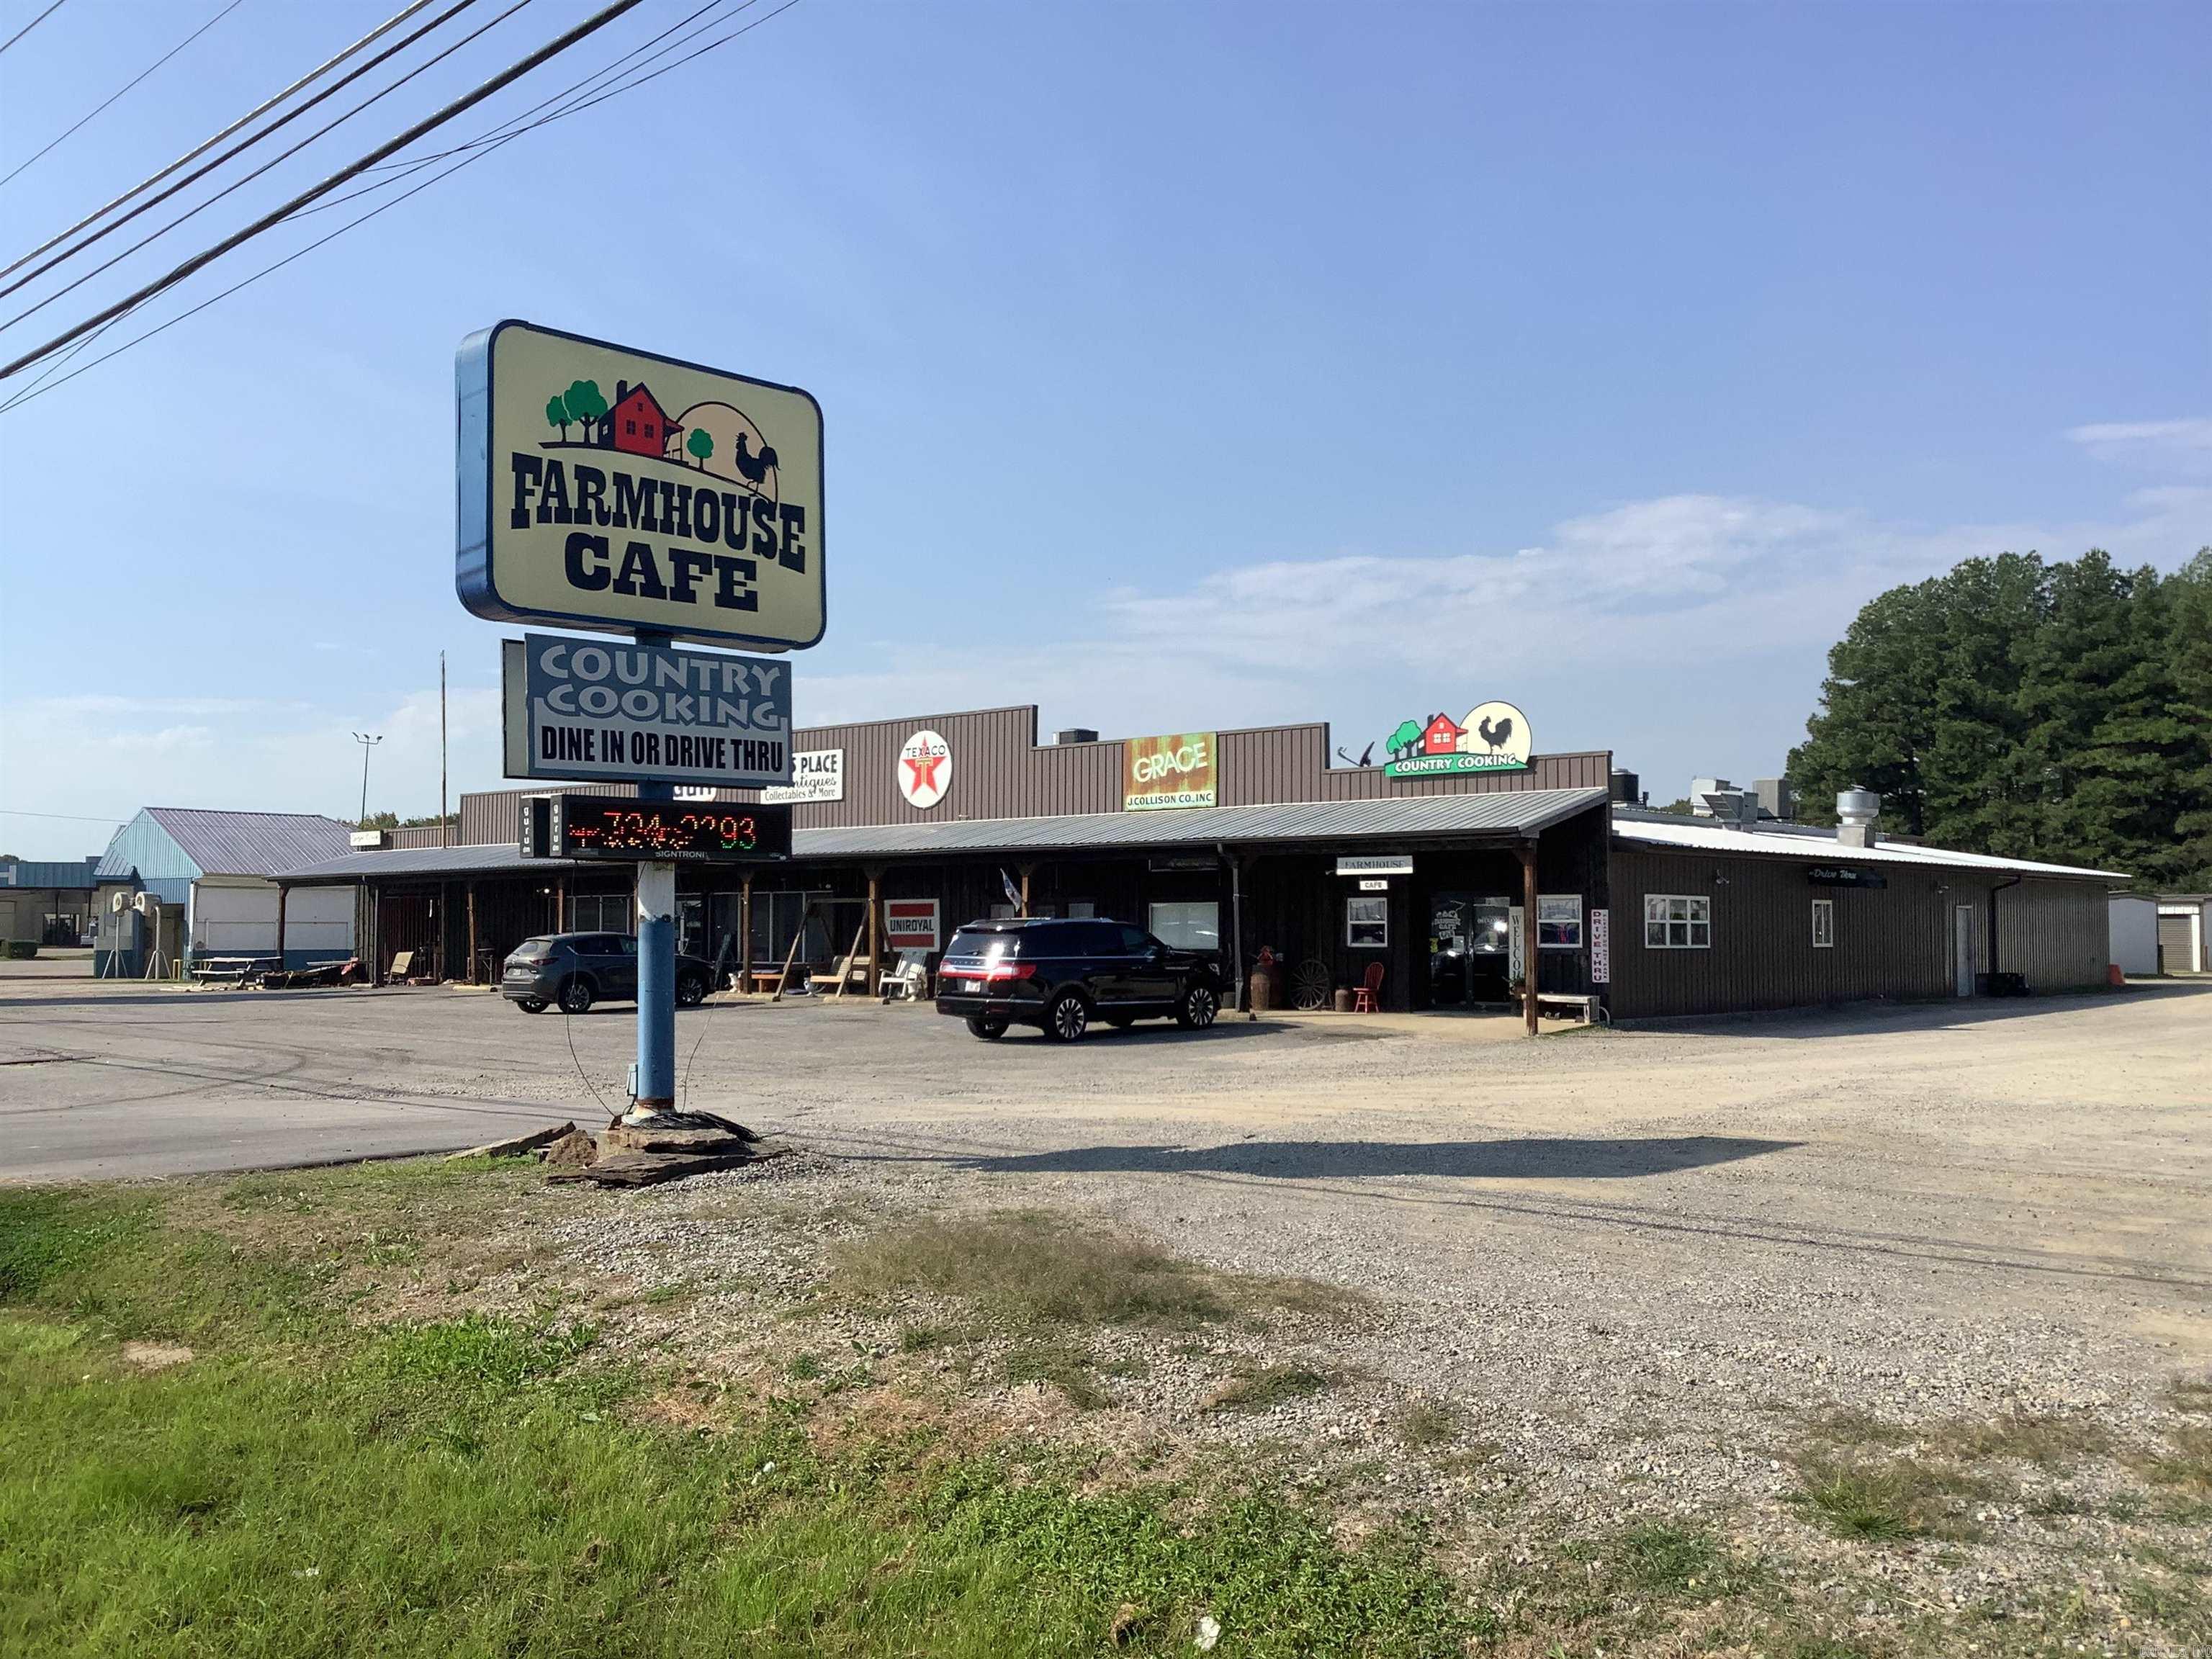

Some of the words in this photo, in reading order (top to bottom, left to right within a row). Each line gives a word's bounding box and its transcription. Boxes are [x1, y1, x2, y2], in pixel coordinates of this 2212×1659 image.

[511, 451, 806, 575] FARMHOUSE
[565, 531, 759, 612] CAFE
[540, 644, 781, 696] COUNTRY
[547, 683, 778, 727] COOKING
[541, 725, 595, 762] DINE
[601, 729, 625, 763] IN
[631, 731, 660, 765] OR
[665, 734, 727, 769] DRIVE
[730, 738, 783, 773] THRU
[801, 754, 837, 773] PLACE
[905, 745, 946, 757] TEXACO
[1133, 742, 1208, 783] GRACE
[1395, 758, 1453, 773] COUNTRY
[1457, 753, 1517, 768] COOKING
[765, 786, 806, 801] Collectables
[819, 788, 835, 798] More
[793, 775, 837, 794] ntiques
[890, 919, 935, 932] UNIROYAL
[1593, 911, 1601, 948] DRIVE
[1513, 915, 1521, 979] WELCOM
[1593, 952, 1602, 981] THRU
